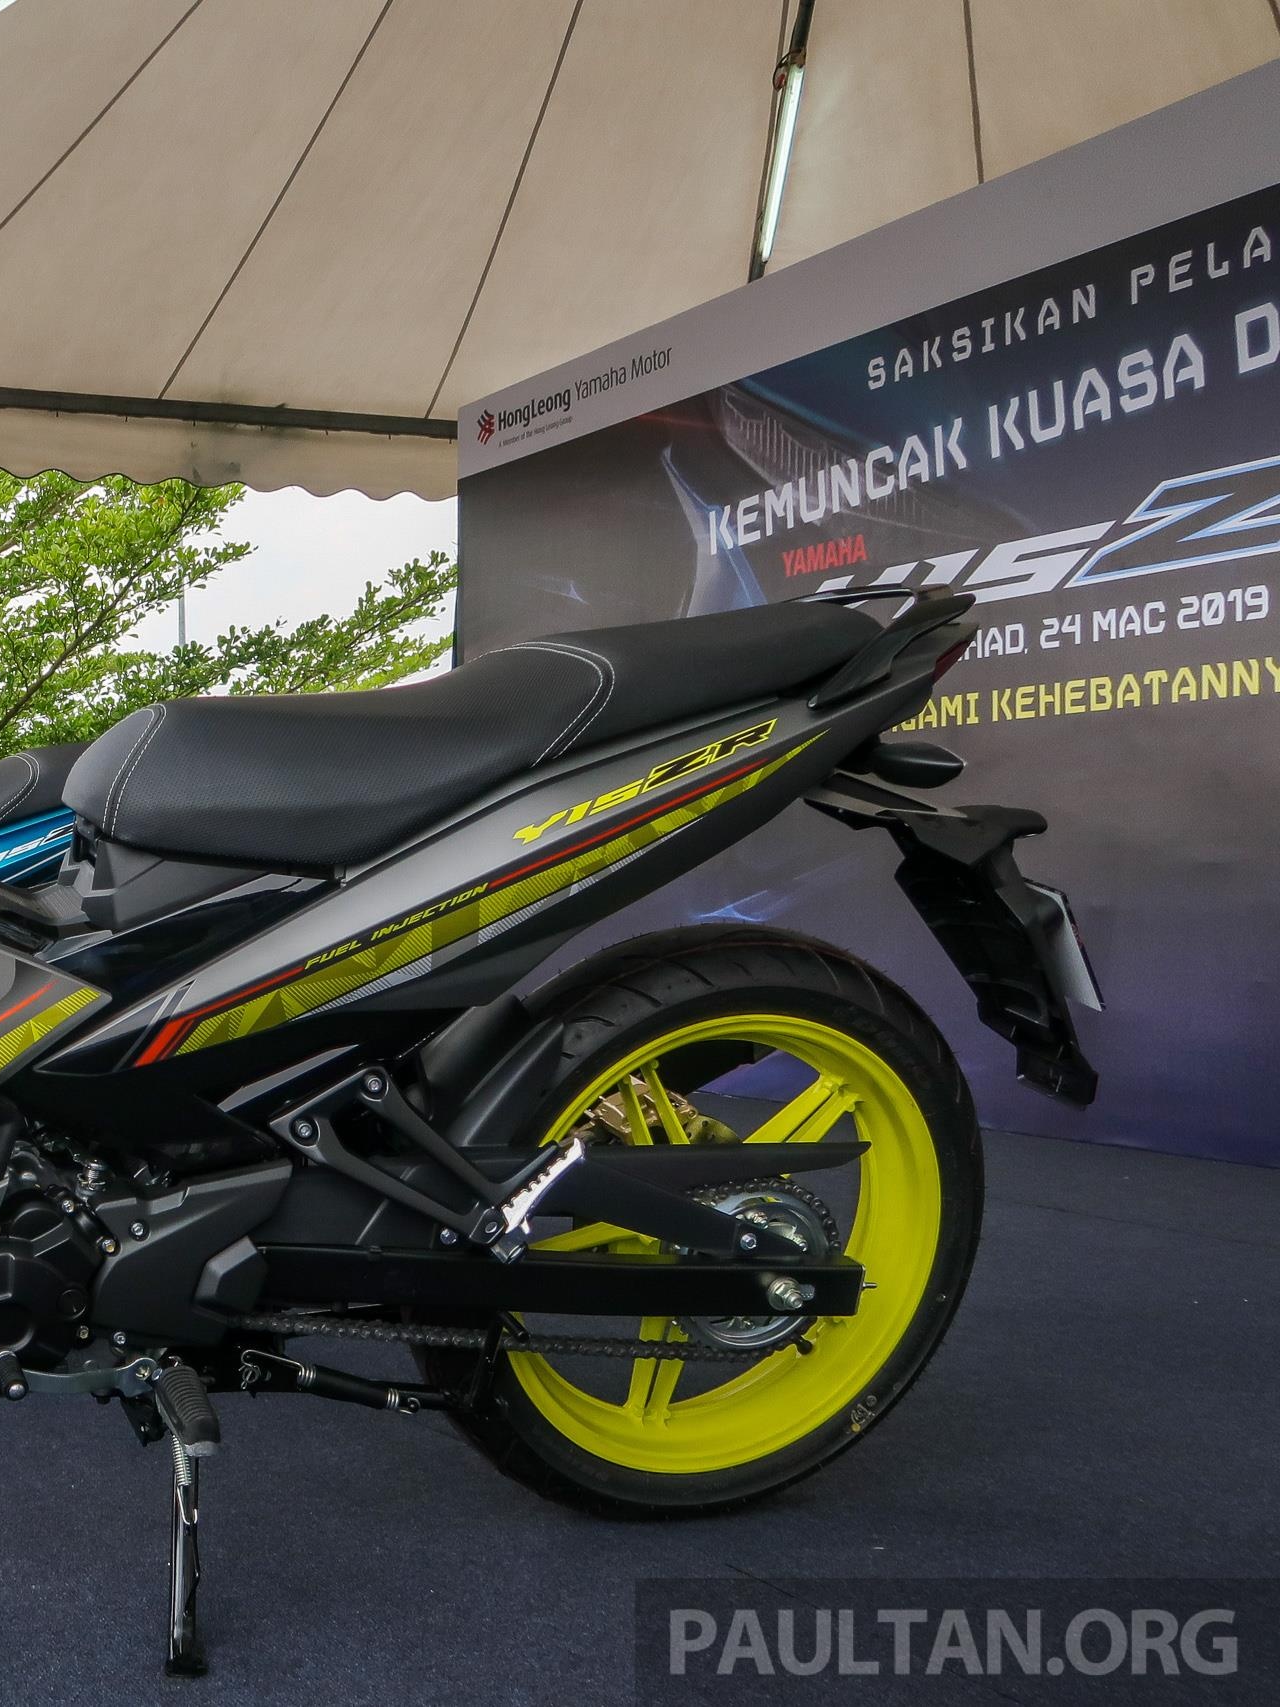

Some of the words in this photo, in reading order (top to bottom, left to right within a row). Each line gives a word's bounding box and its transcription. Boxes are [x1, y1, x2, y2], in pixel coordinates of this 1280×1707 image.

[866, 283, 1097, 390] SAKSIKAN
[1130, 225, 1272, 305] PELA
[497, 388, 571, 431] HongLeong
[574, 366, 627, 401] Yamaha
[630, 347, 672, 381] Motor
[708, 417, 969, 556] KEMUNCAK
[988, 333, 1206, 460] KUASA
[1234, 301, 1280, 374] D
[782, 533, 868, 577] YAMAHA
[958, 623, 1029, 662] HAD,
[1039, 613, 1081, 650] 24
[1092, 600, 1167, 642] MAC
[1177, 584, 1270, 630] 2019
[512, 717, 778, 846] Y15ZR
[304, 939, 362, 970] FUEL
[370, 882, 490, 942] INJECTION
